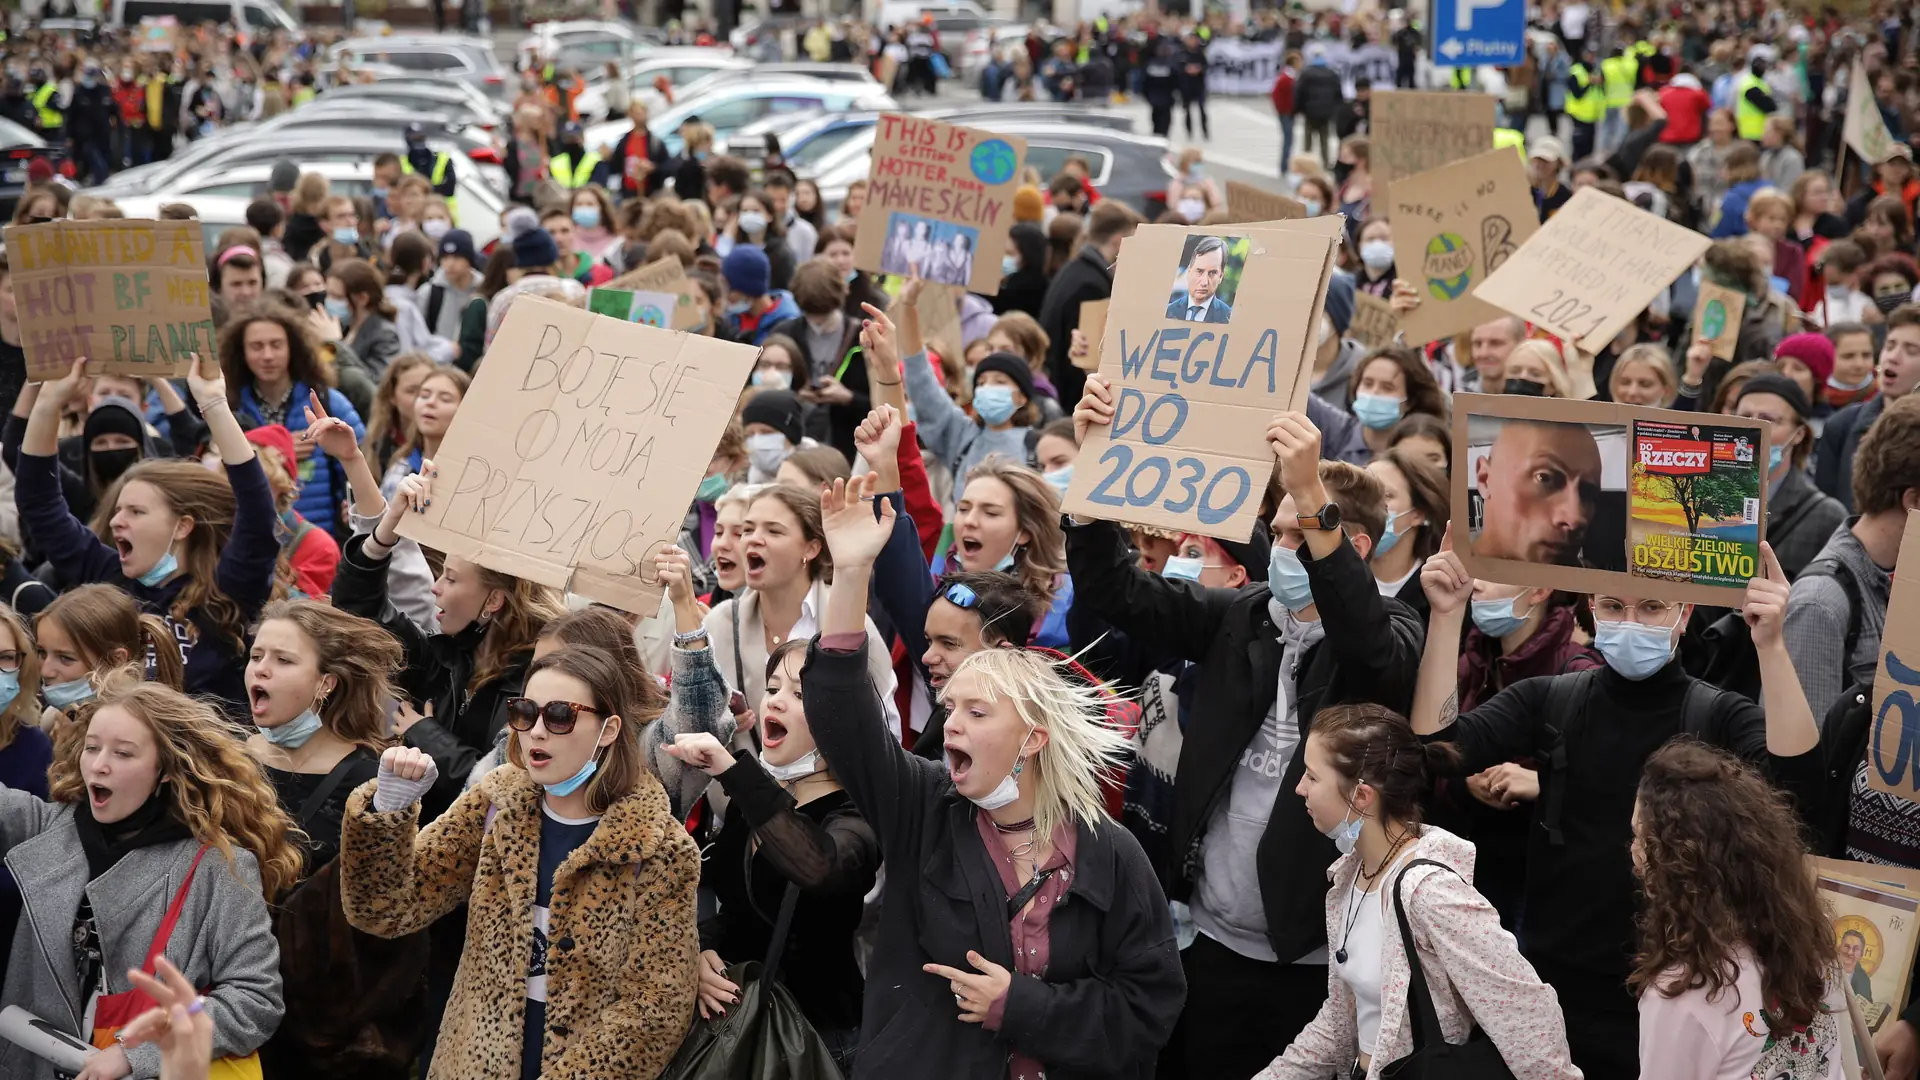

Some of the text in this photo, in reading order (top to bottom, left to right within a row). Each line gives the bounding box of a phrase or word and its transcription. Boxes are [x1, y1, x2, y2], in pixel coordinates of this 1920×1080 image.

[881, 115, 968, 152] THIS IS
[877, 156, 948, 183] HOTTER
[898, 144, 956, 164] GETTING
[1399, 203, 1445, 222] THERE
[37, 227, 156, 267] WANTED
[171, 227, 196, 265] A
[1429, 247, 1471, 273] PLANET
[22, 272, 96, 319] HOT
[112, 271, 153, 310] BF
[1530, 289, 1608, 340] 2021
[110, 320, 219, 366] PLANET
[1119, 327, 1278, 393] WĘGLA
[518, 323, 700, 427] BOJĘ SIĘ
[515, 408, 560, 463] O
[1109, 387, 1189, 446] DO
[1640, 443, 1653, 451] DO
[1640, 451, 1708, 468] RZECZY
[1086, 444, 1252, 525] 2030
[1633, 544, 1754, 578] OSZUSTWO
[1645, 533, 1742, 555] WIELKIE ZIELONE
